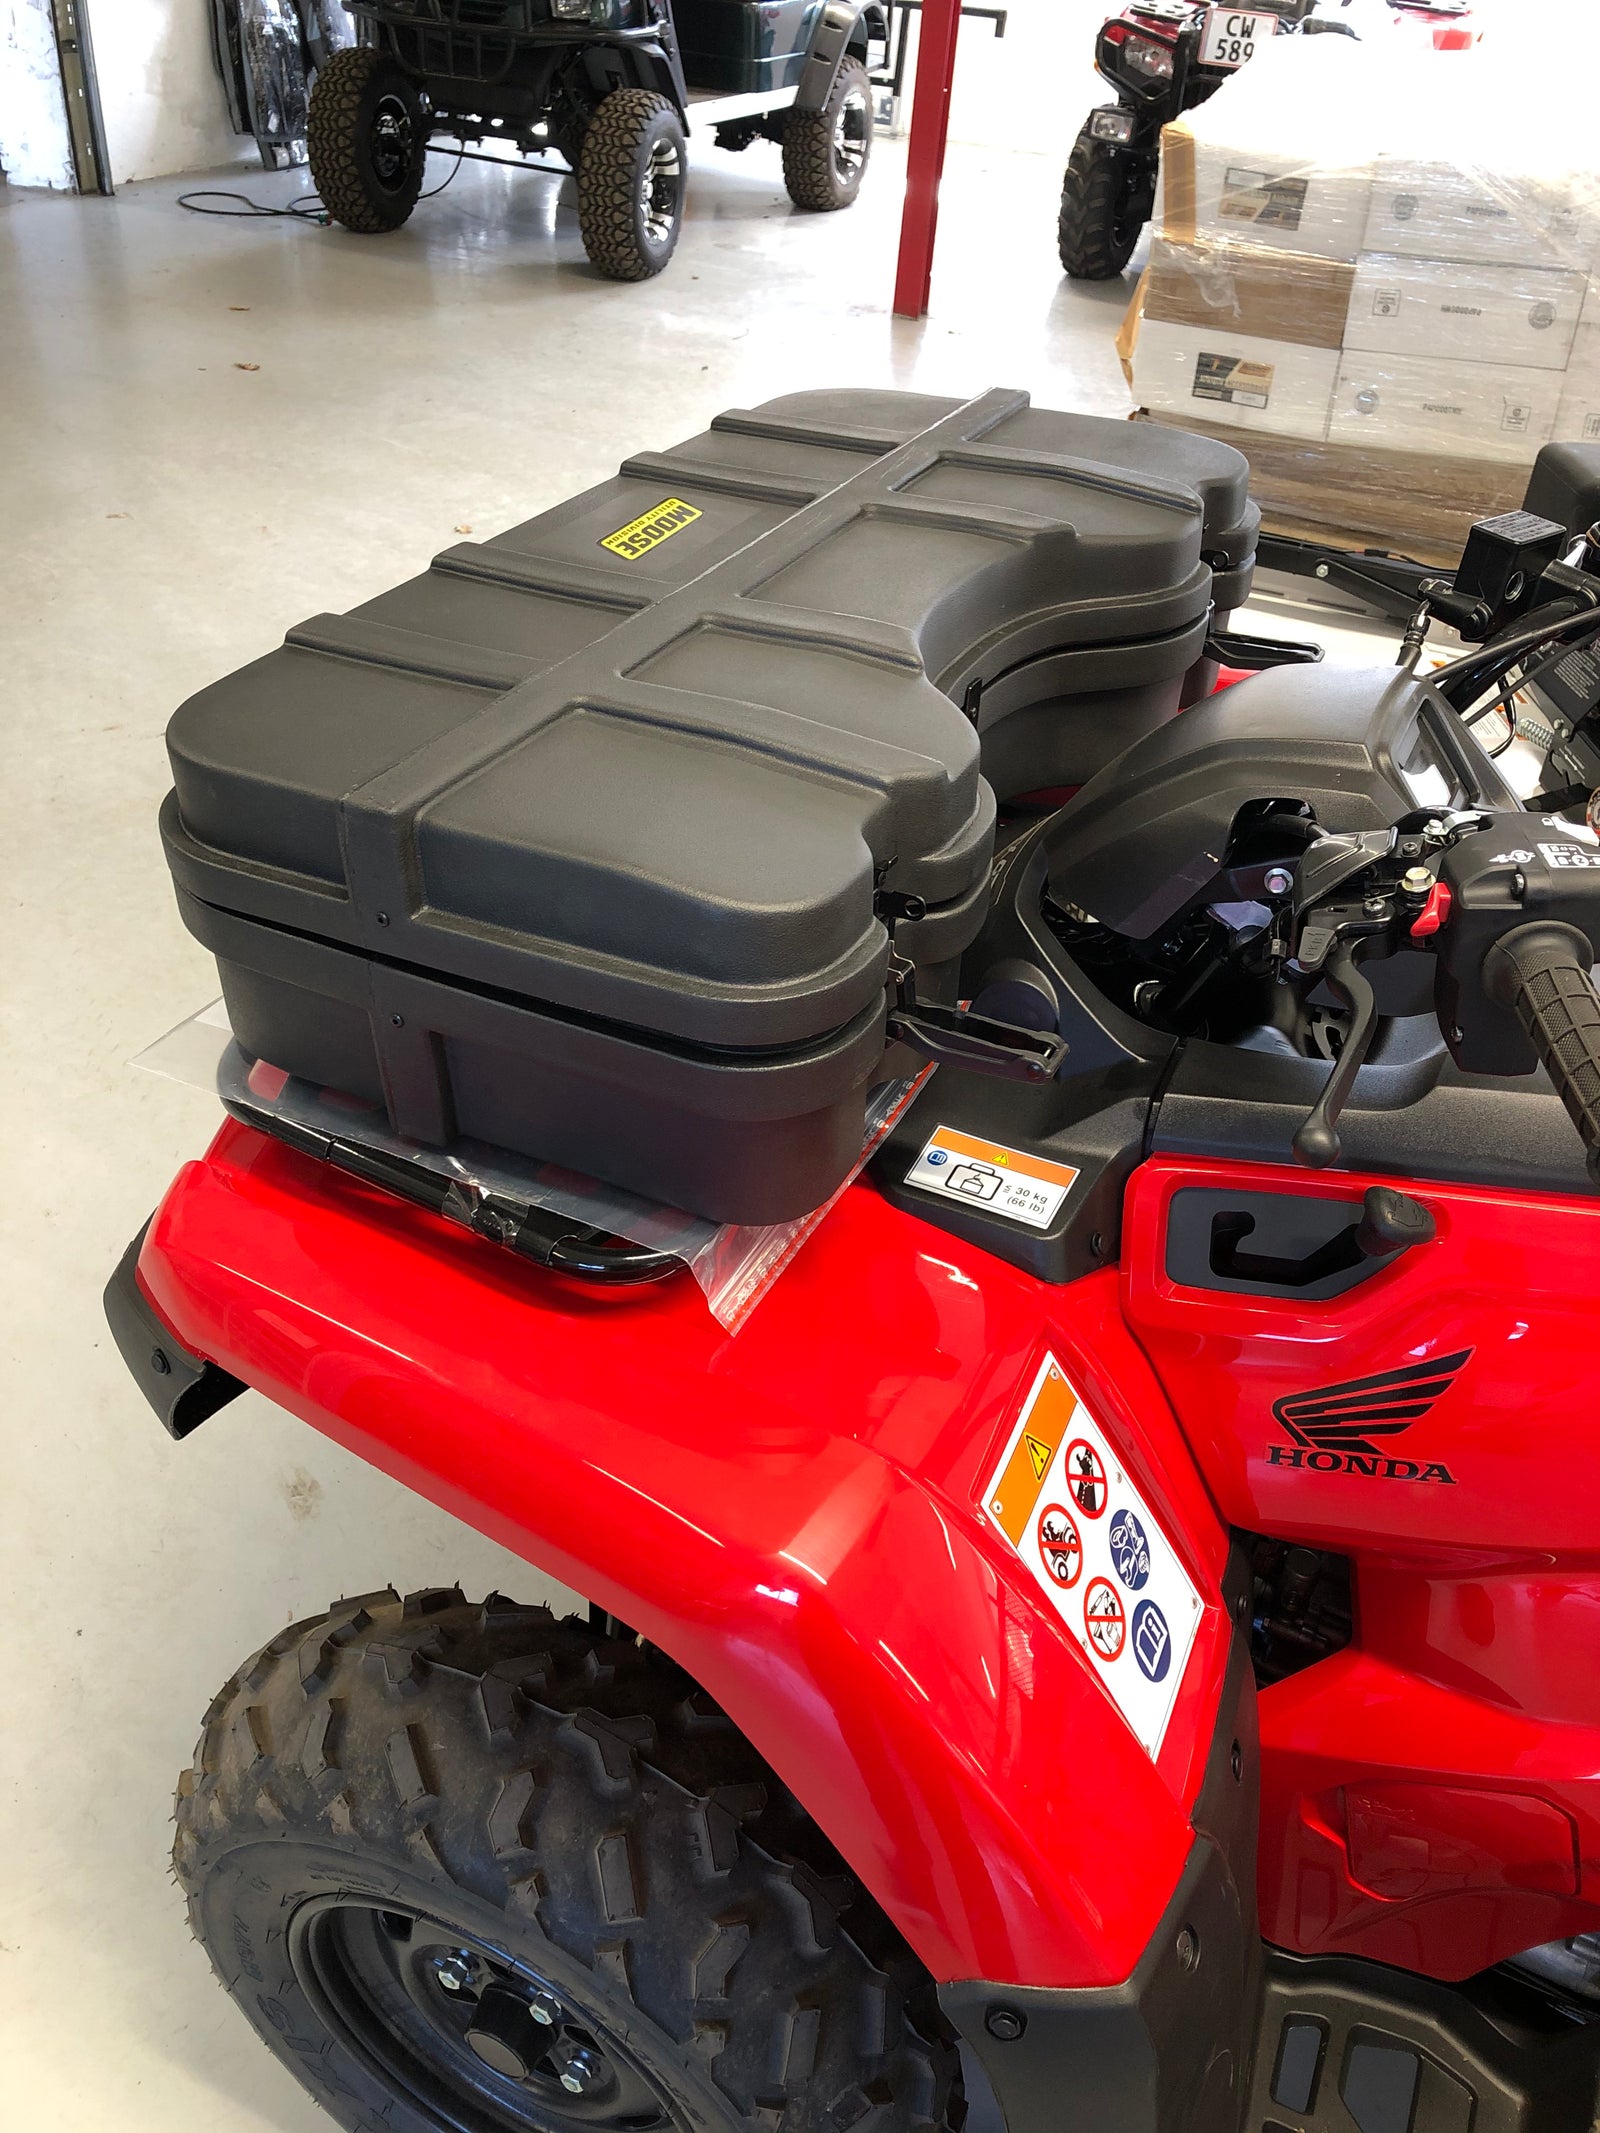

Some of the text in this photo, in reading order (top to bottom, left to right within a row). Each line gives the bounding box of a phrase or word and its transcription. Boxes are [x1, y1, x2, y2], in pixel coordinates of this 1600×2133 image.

[1226, 14, 1256, 39] CW
[1214, 38, 1255, 62] 589
[605, 500, 676, 546] UTILITY DIVISION
[614, 504, 697, 556] MOOSE
[1006, 1196, 1045, 1214] (66 lb)
[1016, 1187, 1030, 1197] 30
[1033, 1192, 1048, 1205] kg
[1265, 1446, 1457, 1485] HONDA
